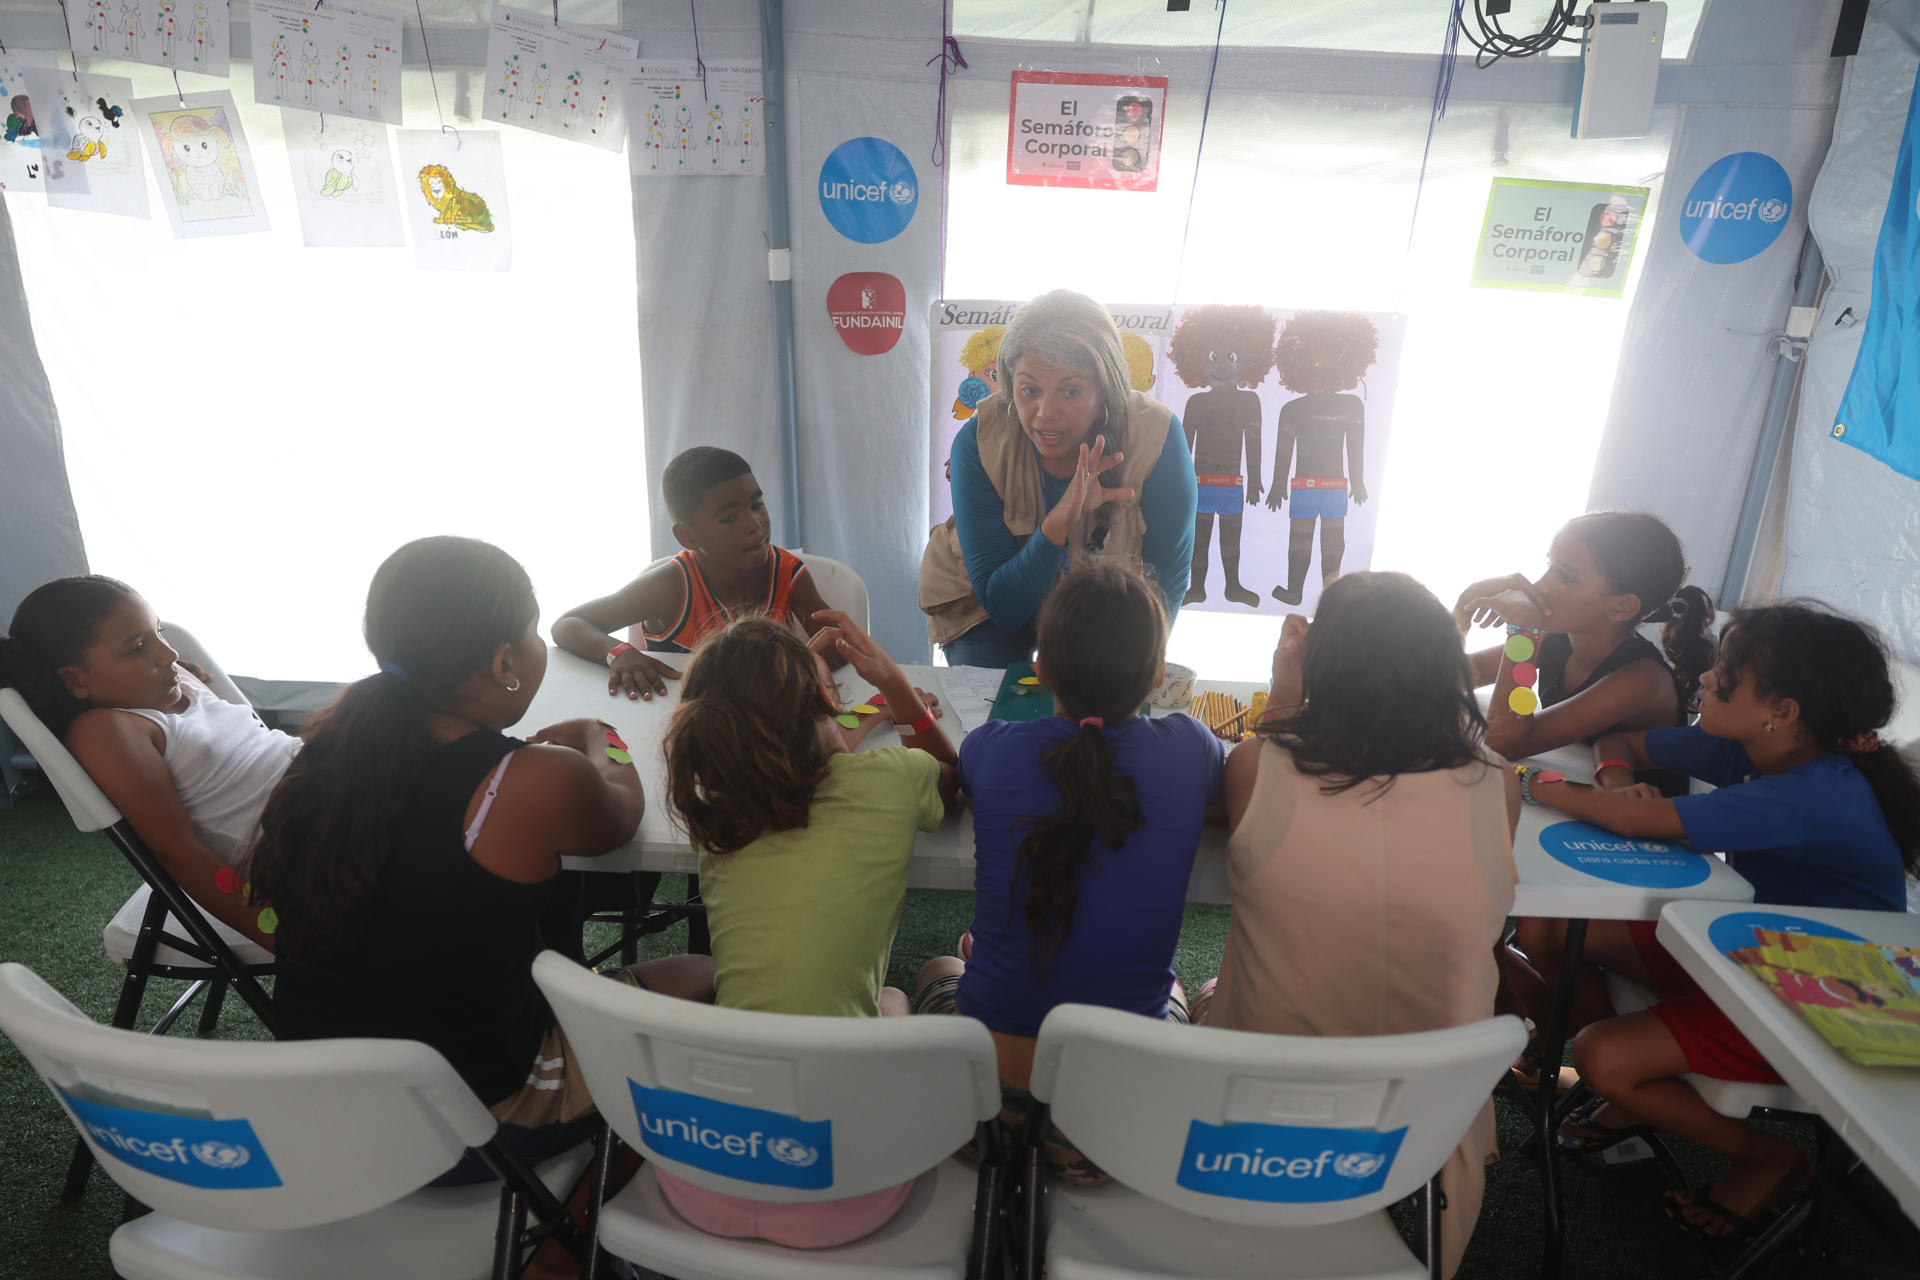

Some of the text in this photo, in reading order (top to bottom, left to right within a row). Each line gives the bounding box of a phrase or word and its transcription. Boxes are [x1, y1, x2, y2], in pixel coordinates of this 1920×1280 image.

[1061, 100, 1078, 116] El
[1021, 118, 1114, 138] Semáforo
[1025, 139, 1107, 158] Corporal
[823, 179, 888, 204] unicef
[1533, 206, 1553, 222] El
[1686, 196, 1758, 222] unicef
[1491, 223, 1584, 244] Semáforo
[1492, 242, 1575, 263] Corporal
[832, 316, 905, 328] FUNDAINIL
[1562, 839, 1638, 853] unicef
[640, 1110, 764, 1158] unicef
[1195, 1147, 1336, 1179] unicef
